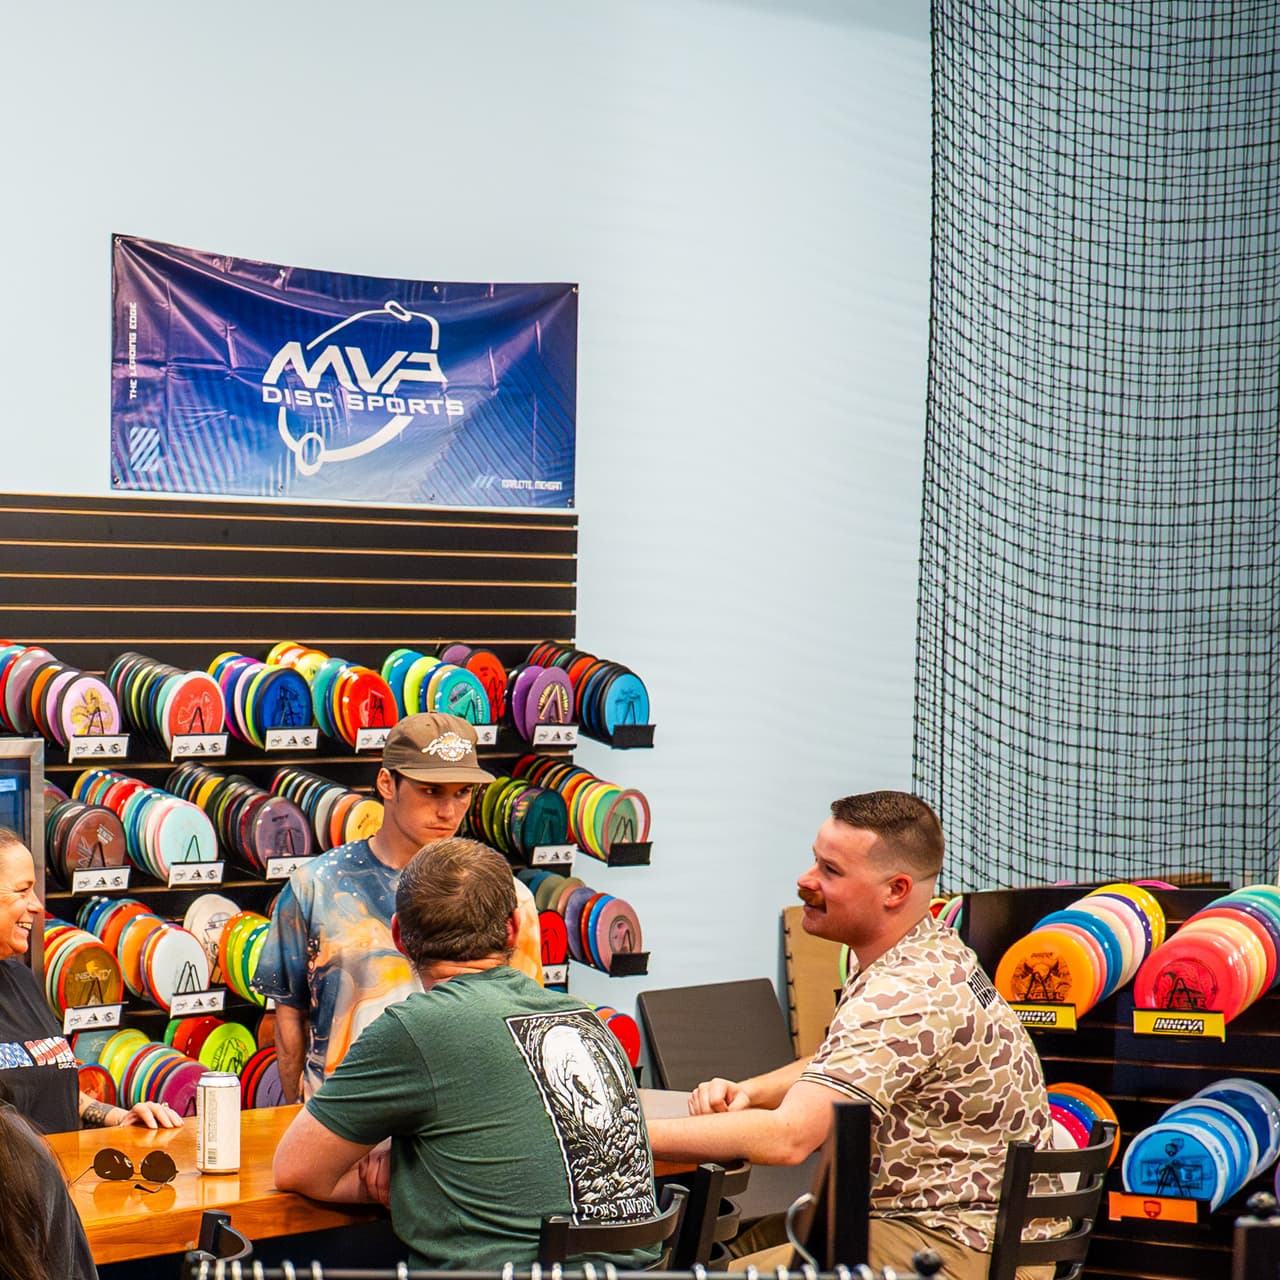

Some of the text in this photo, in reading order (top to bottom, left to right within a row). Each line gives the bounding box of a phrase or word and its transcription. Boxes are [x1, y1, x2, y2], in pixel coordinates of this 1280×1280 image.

[128, 302, 137, 399] THE LEADING EDGE
[263, 341, 448, 394] MVP
[263, 386, 465, 416] DISC SPORTS
[1013, 1010, 1056, 1023] NNOVA
[1155, 1018, 1204, 1031] INNOVA
[581, 1195, 655, 1220] POE'S TAVERN
